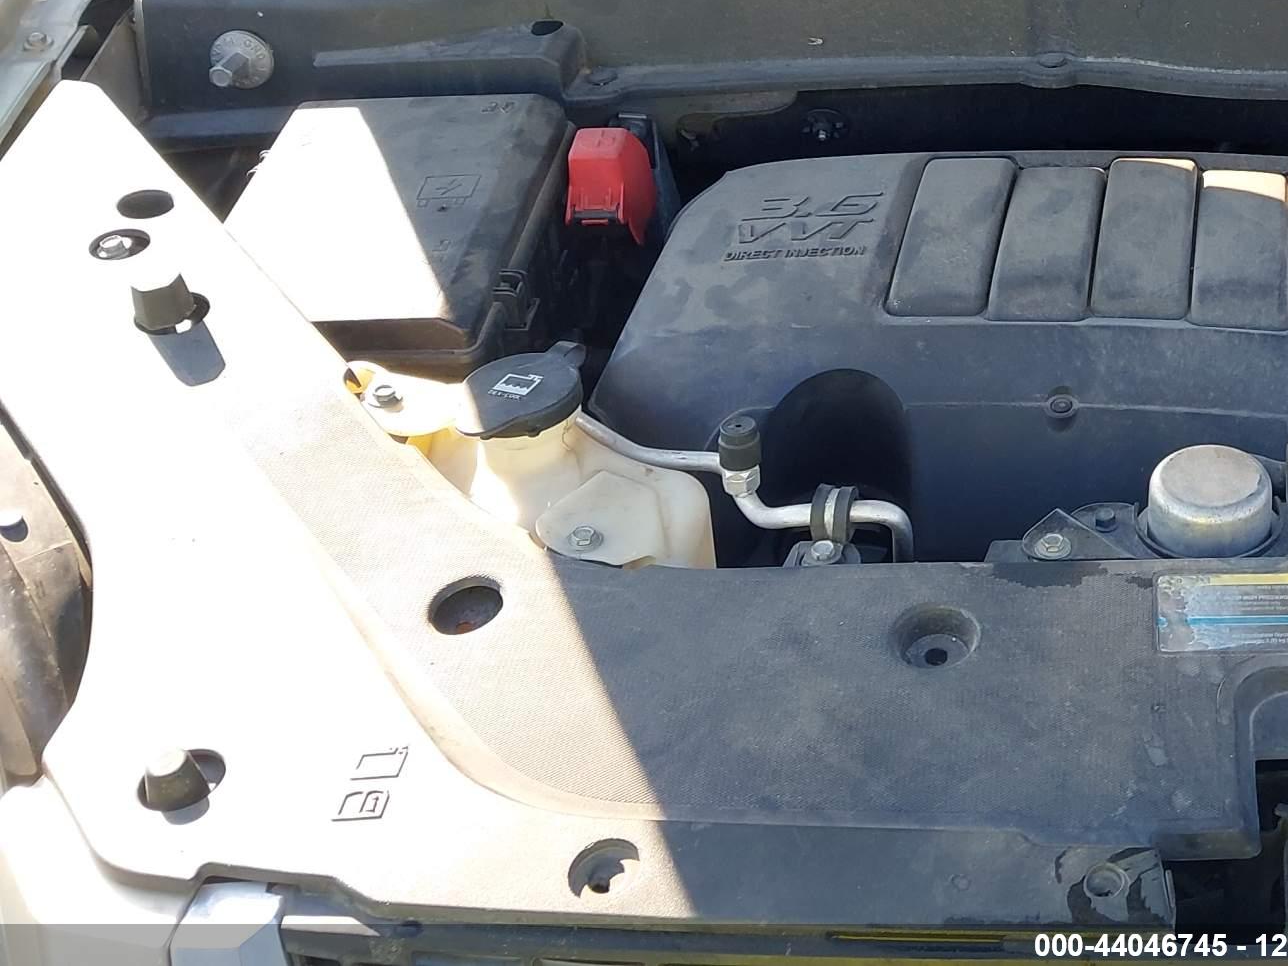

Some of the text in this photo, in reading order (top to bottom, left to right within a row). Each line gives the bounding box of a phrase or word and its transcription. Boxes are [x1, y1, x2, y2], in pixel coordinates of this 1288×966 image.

[741, 191, 885, 222] 3.6
[738, 217, 875, 244] VVT
[725, 244, 867, 261] DIRECT INJECTION
